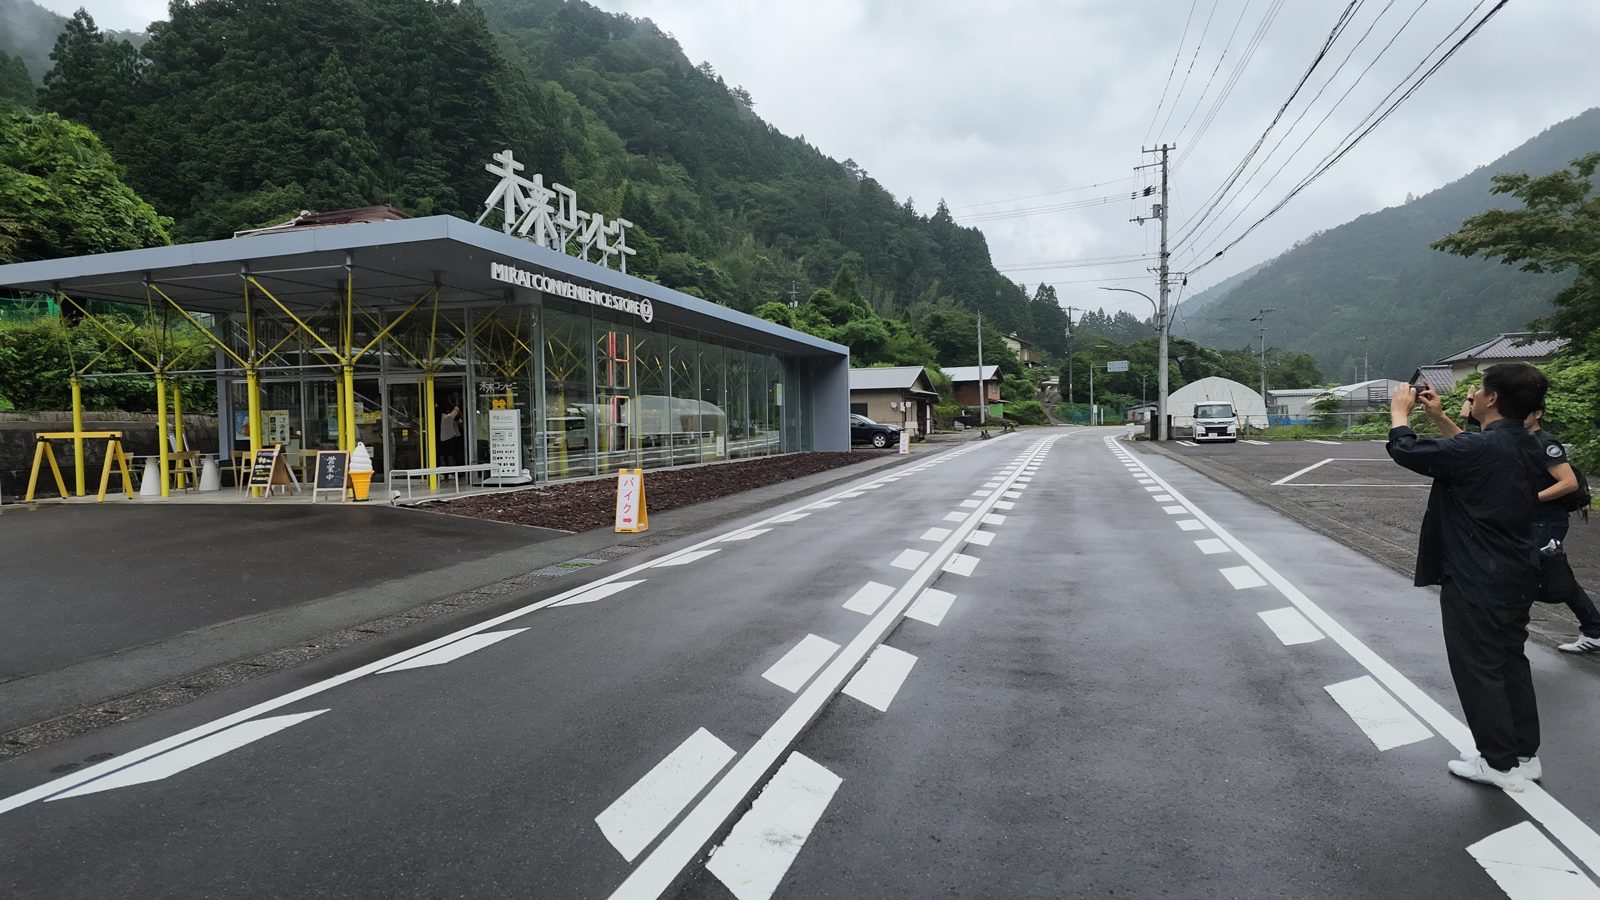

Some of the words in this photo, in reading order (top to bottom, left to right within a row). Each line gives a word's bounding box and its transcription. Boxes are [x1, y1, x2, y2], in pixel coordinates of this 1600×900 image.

[485, 150, 637, 255] 未来コンビニ
[490, 262, 532, 289] MIRAI
[531, 274, 612, 309] CONVENIENCE
[612, 295, 641, 316] STORE
[325, 455, 337, 480] 営業中
[623, 477, 634, 513] バイク
